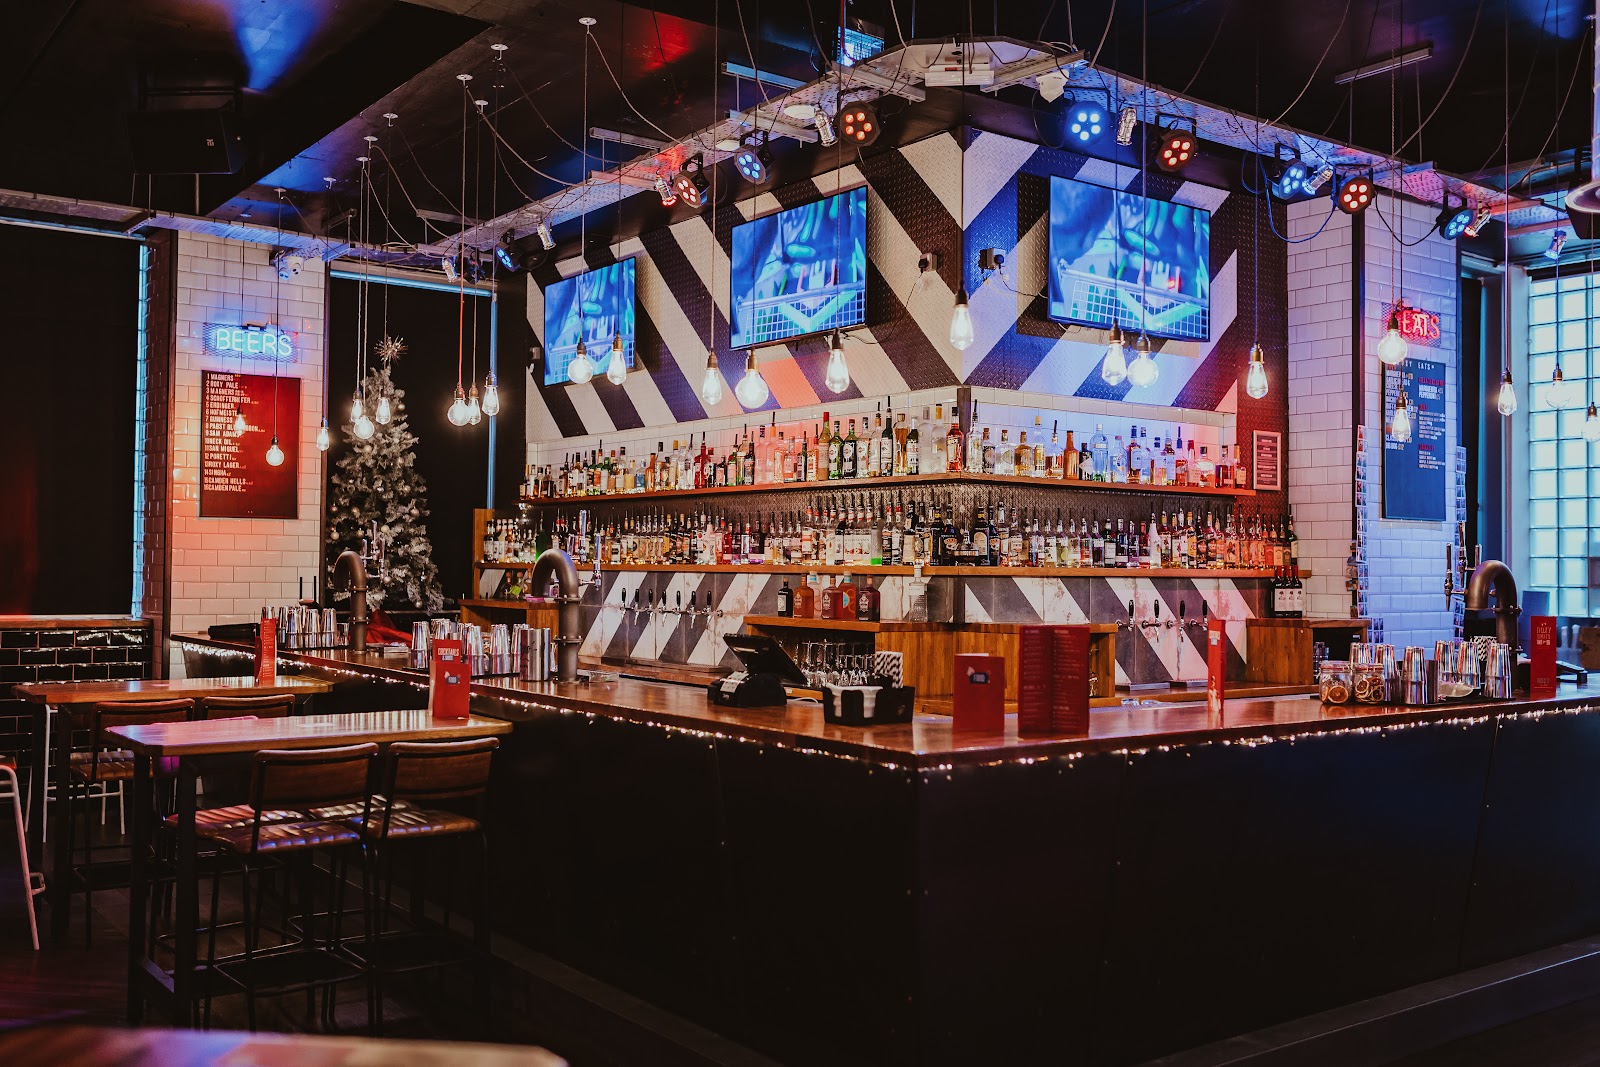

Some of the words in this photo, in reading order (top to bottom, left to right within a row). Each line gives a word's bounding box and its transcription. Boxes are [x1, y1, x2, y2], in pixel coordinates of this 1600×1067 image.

[1402, 310, 1440, 339] EATS
[216, 328, 292, 356] BEERS
[1418, 362, 1430, 370] EATS
[210, 374, 234, 382] MAGNERS
[438, 648, 460, 656] COCKTAILS
